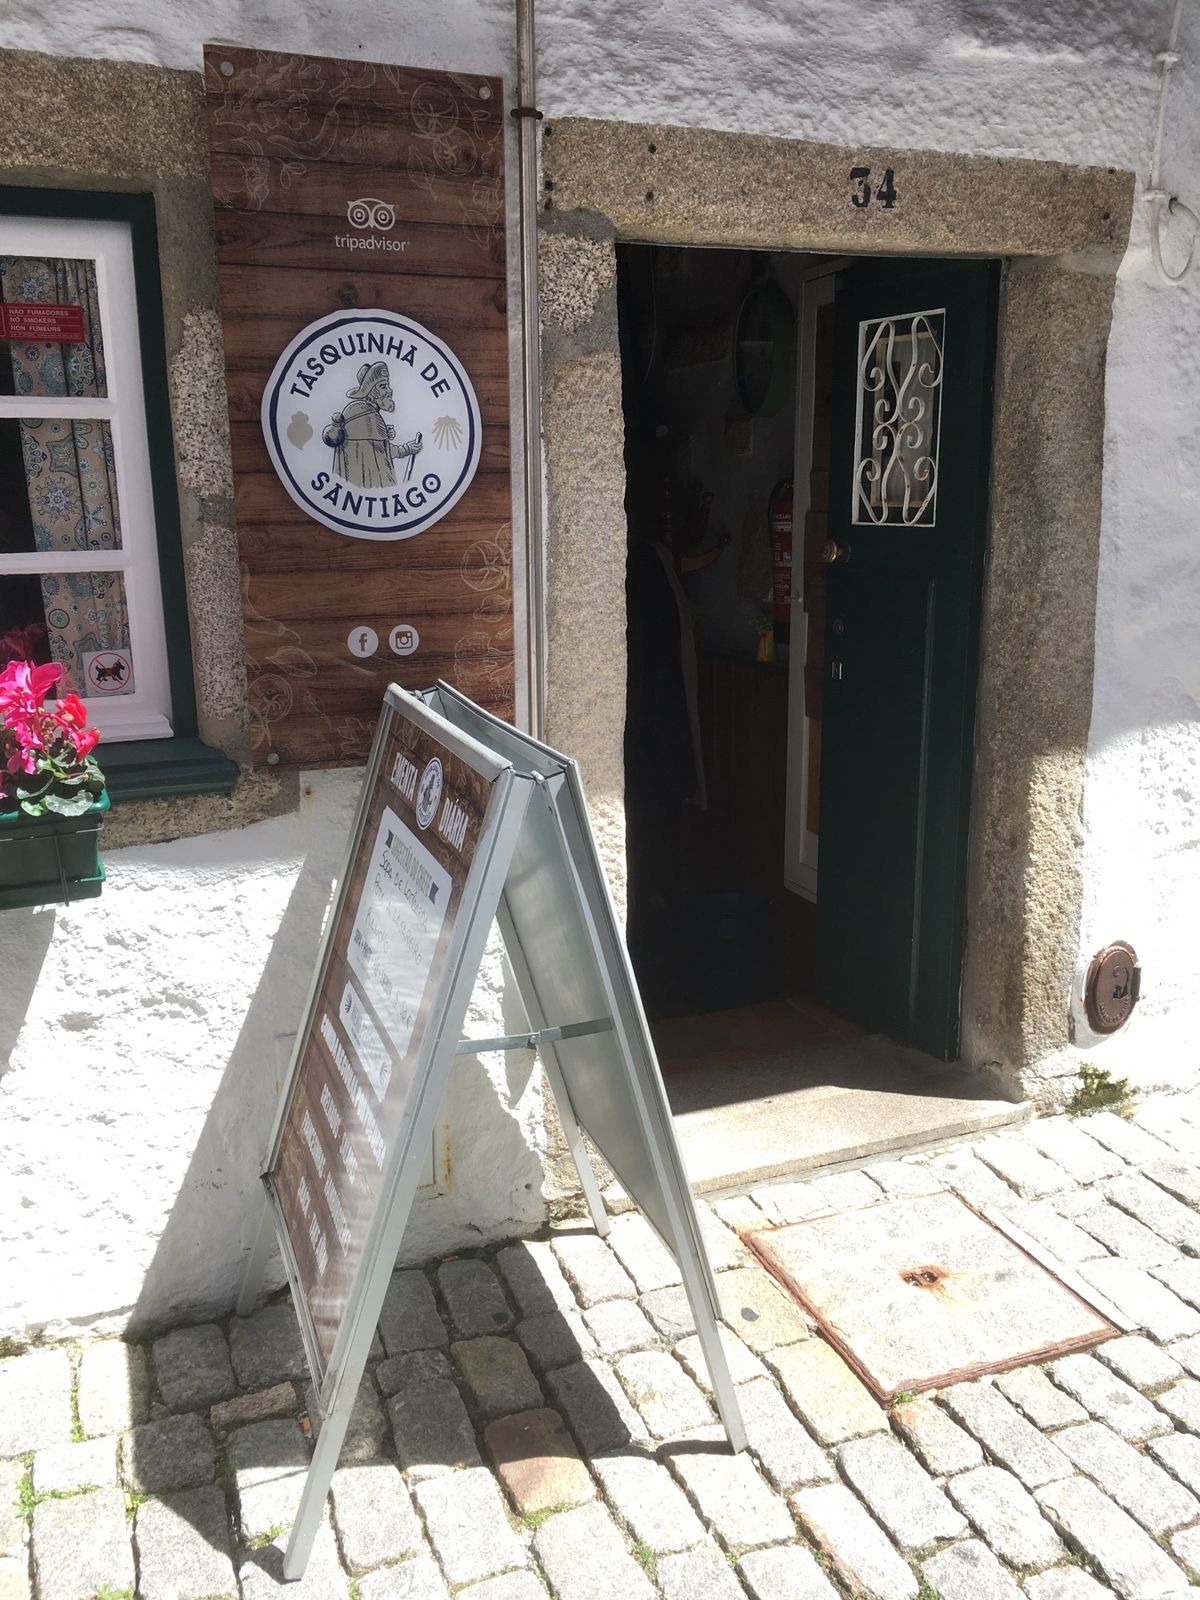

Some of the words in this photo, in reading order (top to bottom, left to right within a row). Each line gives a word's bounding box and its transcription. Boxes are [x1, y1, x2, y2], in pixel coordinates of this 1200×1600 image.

[850, 166, 898, 209] 34
[334, 234, 407, 252] tripadvisor
[28, 325, 62, 333] FUMEURS
[290, 332, 418, 399] TASQUINHA
[420, 362, 451, 399] DE
[310, 471, 442, 519] SANTIAGO
[391, 752, 419, 802] EMENTA
[438, 796, 470, 853] DIÁRIA
[334, 1043, 358, 1105] REGIONAL
[354, 1086, 386, 1171] PORTUGUESA
